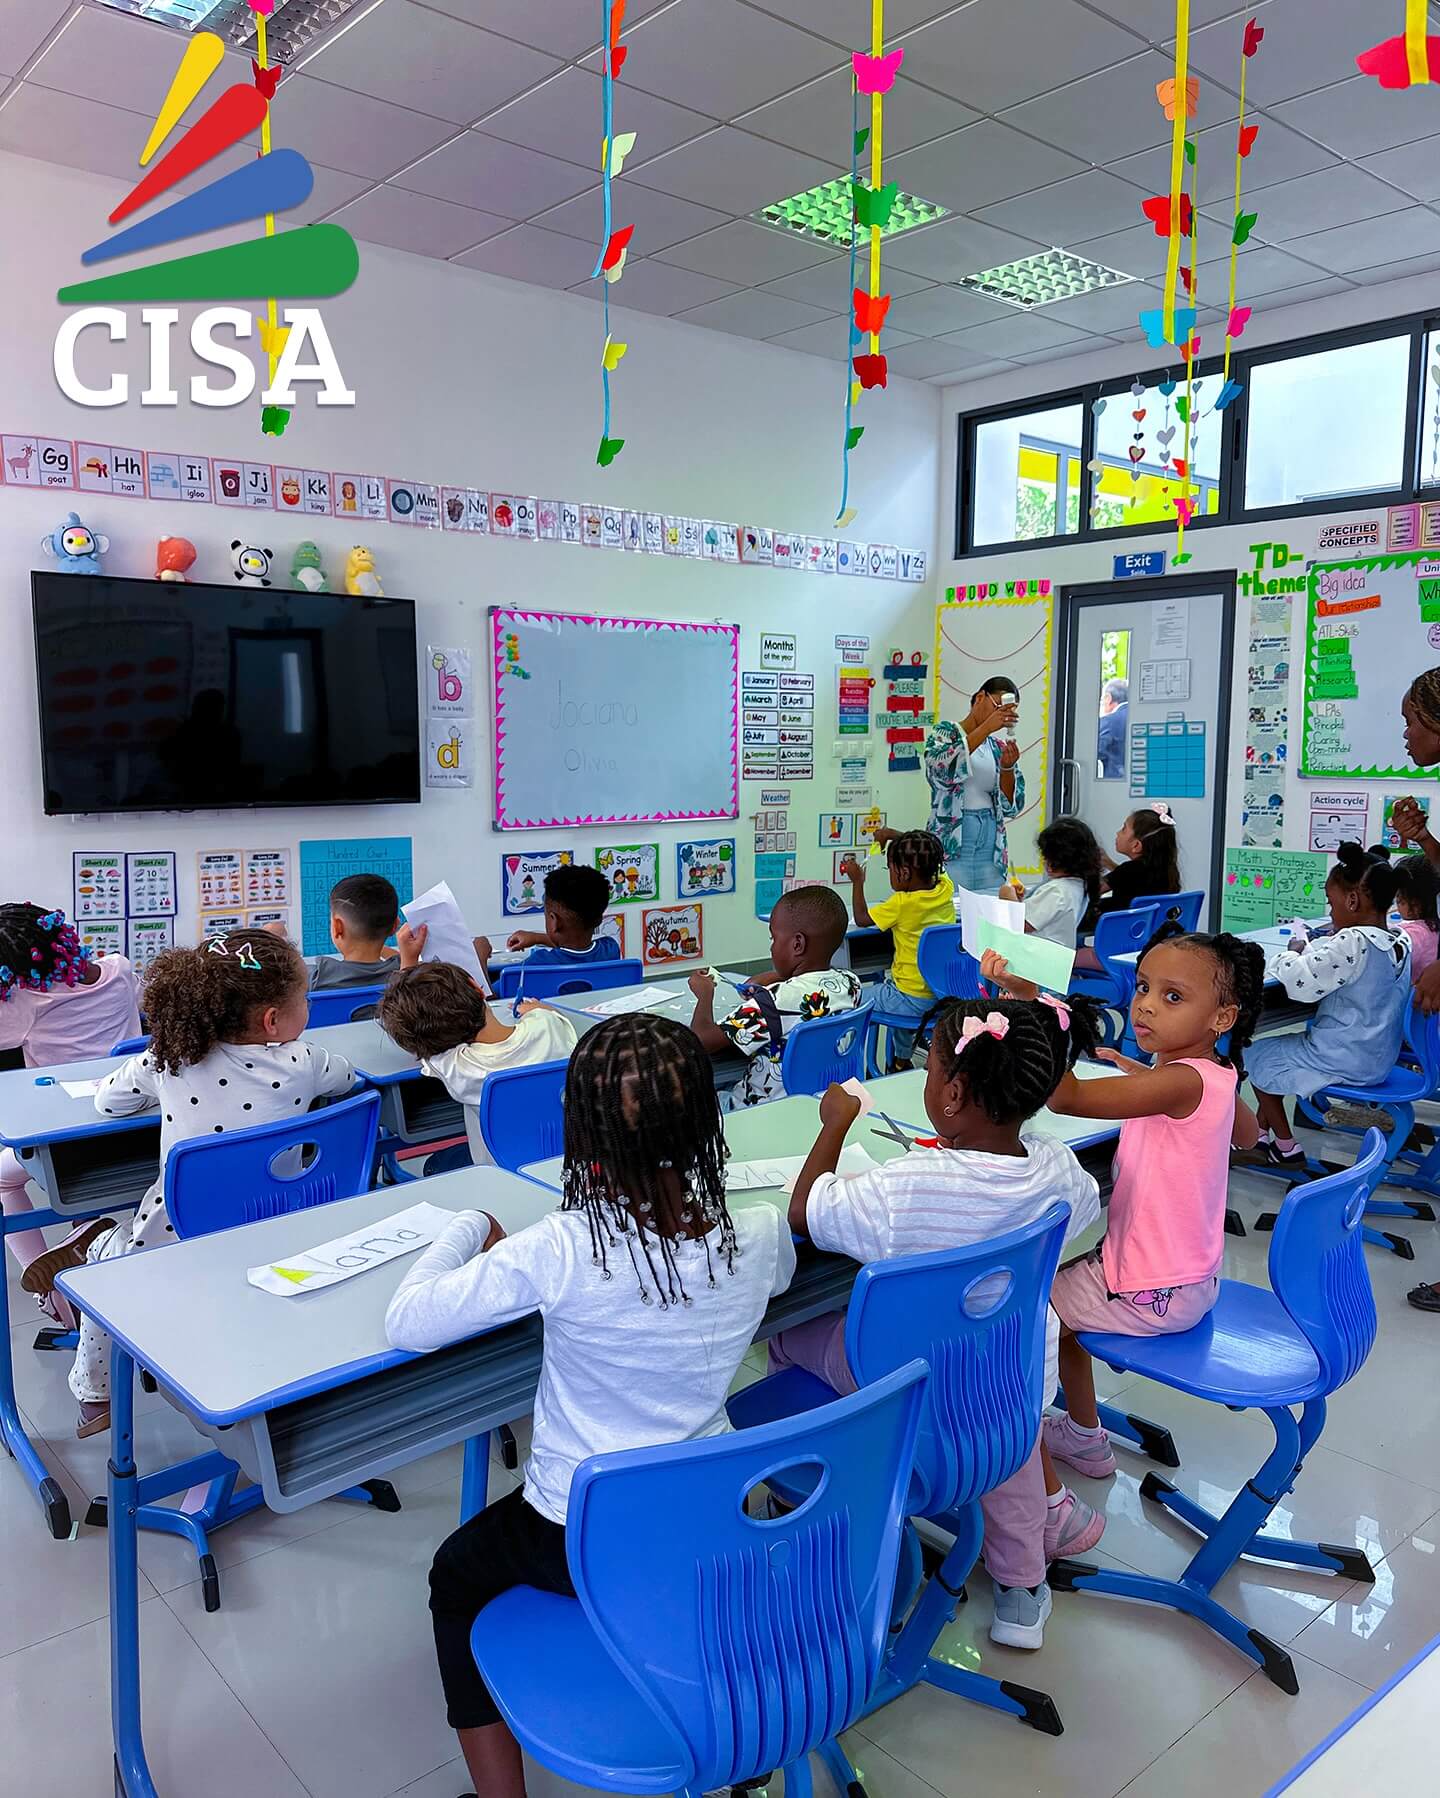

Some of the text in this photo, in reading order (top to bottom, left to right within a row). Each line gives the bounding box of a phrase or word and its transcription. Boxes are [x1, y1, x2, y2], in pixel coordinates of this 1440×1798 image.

[42, 448, 69, 471] Gg
[115, 457, 141, 476] Hh
[187, 464, 202, 481] Ii
[47, 474, 66, 485] goat
[249, 471, 268, 493] Jj
[121, 481, 136, 492] hat
[307, 478, 327, 496] Kk
[366, 484, 380, 500] Ll
[187, 489, 205, 499] igloo
[253, 495, 267, 505] jam
[416, 493, 438, 508] Mm
[310, 503, 325, 512] king
[468, 499, 488, 515] Nn
[517, 505, 534, 520] Oo
[563, 509, 576, 526] Pp
[604, 516, 621, 534] Qq
[646, 521, 660, 534] Rr
[1321, 523, 1378, 537] SPECIFIED
[685, 526, 698, 540] Ss
[760, 537, 772, 549] Uu
[793, 541, 804, 554] Vv
[1319, 535, 1377, 549] CONCEPTS
[823, 546, 836, 557] Xx
[855, 550, 866, 564] Yy
[913, 557, 924, 569] Zz
[1125, 554, 1152, 568] Exit
[1237, 569, 1306, 597] theme
[1320, 571, 1366, 600] Big idea
[946, 580, 1049, 602] PROUD WALL
[764, 640, 794, 651] Months
[837, 639, 850, 647] Days
[752, 677, 775, 686] January
[788, 678, 811, 687] February
[751, 696, 773, 704] March
[788, 696, 804, 705] April
[752, 714, 766, 723] May
[752, 731, 765, 741] July
[787, 733, 808, 742] August
[761, 794, 790, 802] Weather
[1314, 796, 1364, 806] Action cycle
[695, 850, 719, 859] Winter
[1238, 851, 1262, 864] Math
[616, 855, 641, 867] Spring
[522, 863, 557, 873] Summer
[660, 914, 689, 926] Autumn
[159, 932, 166, 940] 6
